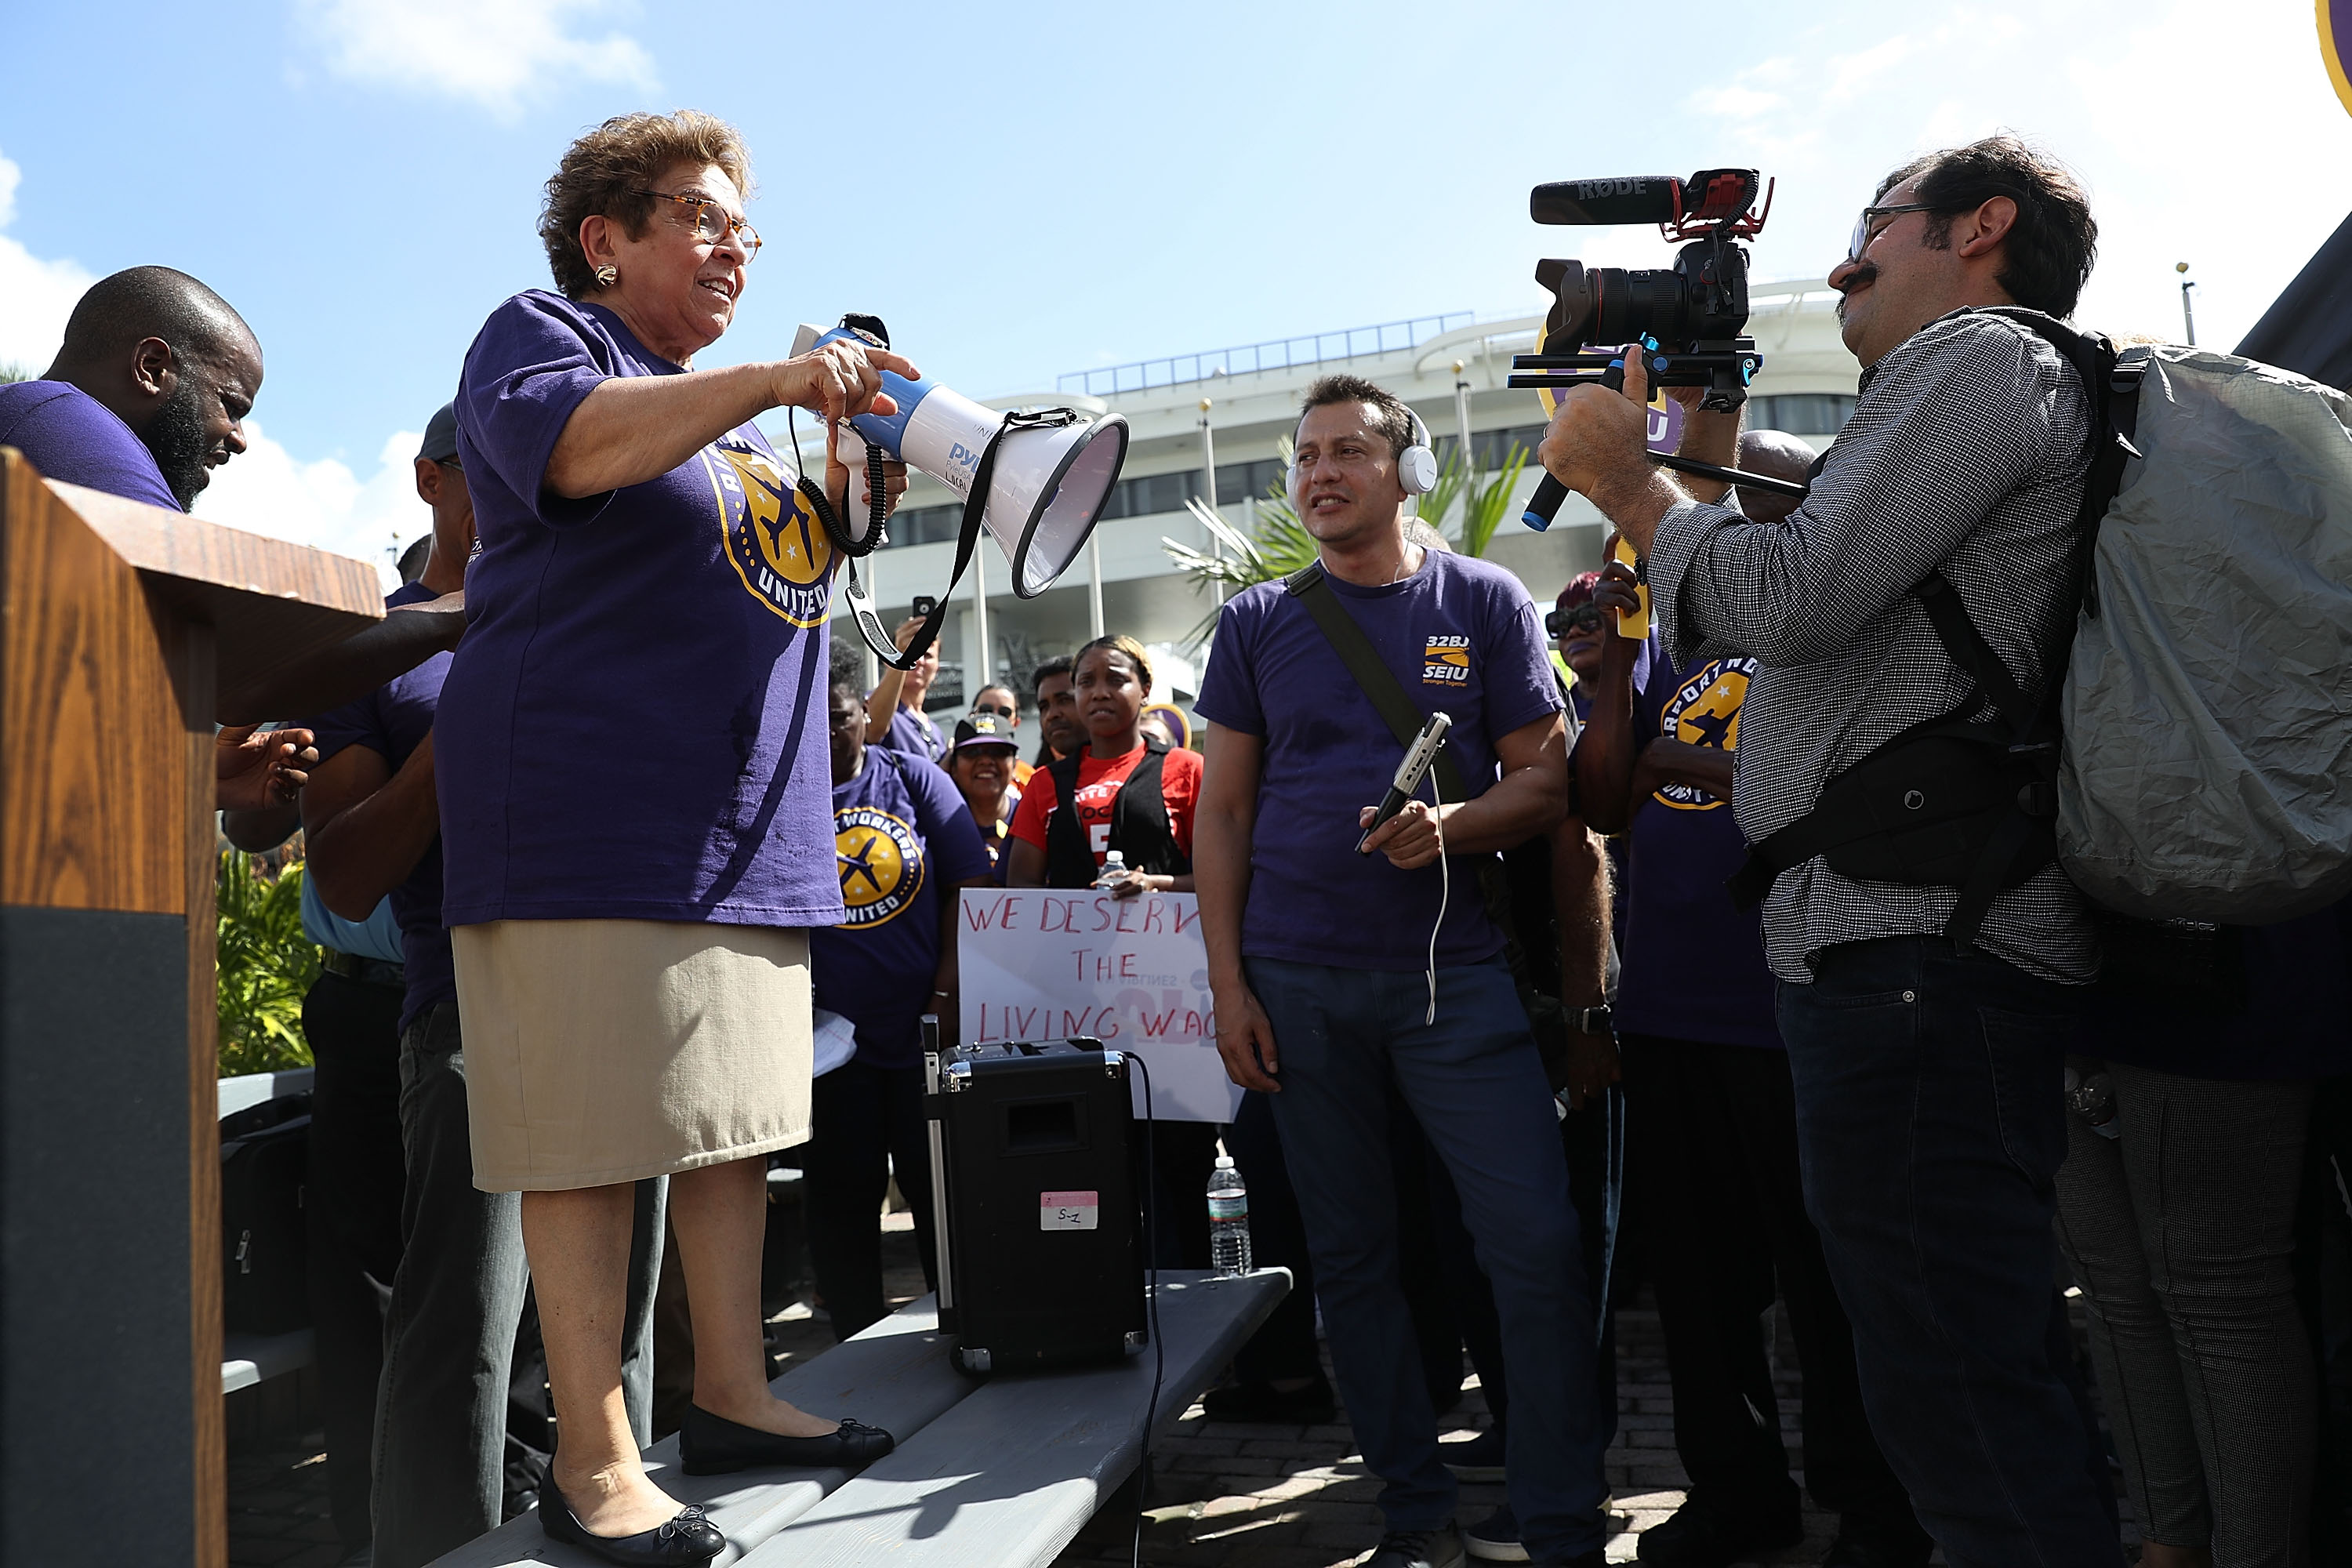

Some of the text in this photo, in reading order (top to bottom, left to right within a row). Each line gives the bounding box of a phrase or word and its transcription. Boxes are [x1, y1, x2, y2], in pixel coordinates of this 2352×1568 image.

[1577, 179, 1646, 200] RØDE
[945, 470, 969, 493] LOCAL
[758, 566, 828, 615] UNITED
[1426, 635, 1470, 648] 32BJ
[1422, 666, 1469, 681] SEIU
[843, 812, 916, 859] WORKERS
[846, 895, 899, 923] NITED
[964, 893, 1200, 935] WE DESERV
[1073, 948, 1138, 982] THE
[980, 1002, 1119, 1043] LIVING
[1058, 1208, 1081, 1224] S-1
